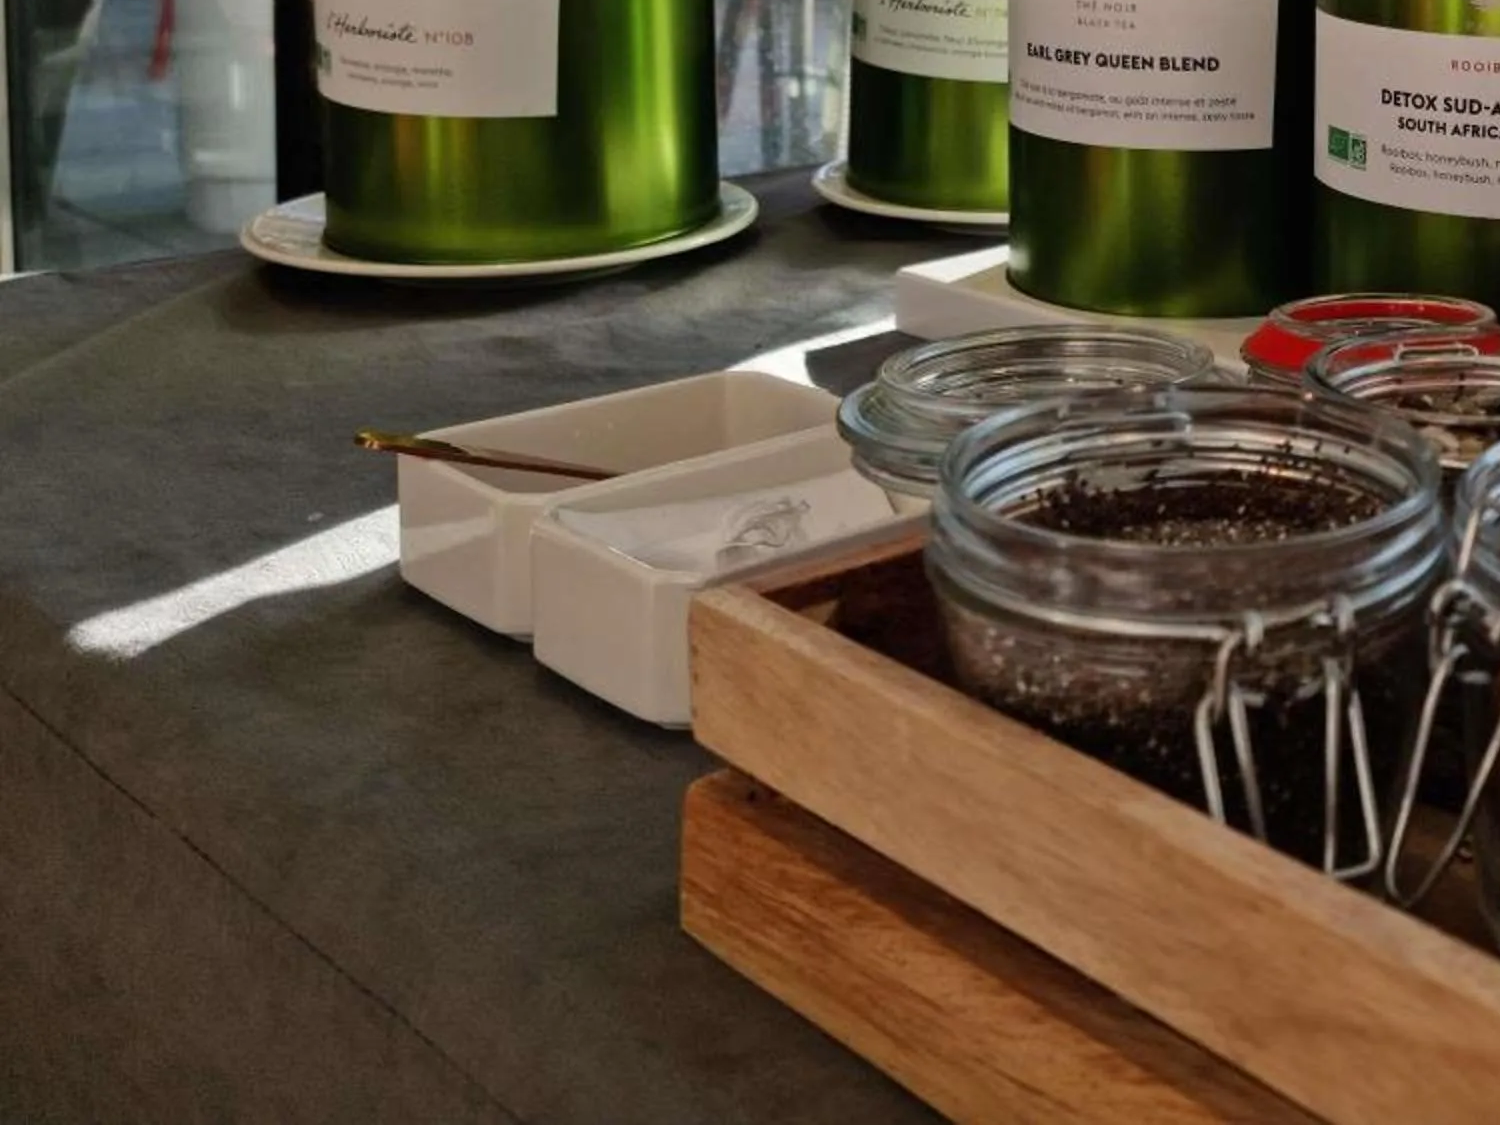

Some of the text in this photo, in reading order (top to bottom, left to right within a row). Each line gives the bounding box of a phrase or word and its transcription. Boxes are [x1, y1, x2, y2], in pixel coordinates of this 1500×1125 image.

[1026, 42, 1053, 62] EARL
[1054, 48, 1092, 68] GREY
[1095, 52, 1155, 71] QUEEN
[1159, 56, 1221, 73] BLEND
[1380, 87, 1438, 113] DETOX
[1397, 115, 1447, 137] SOUTH
